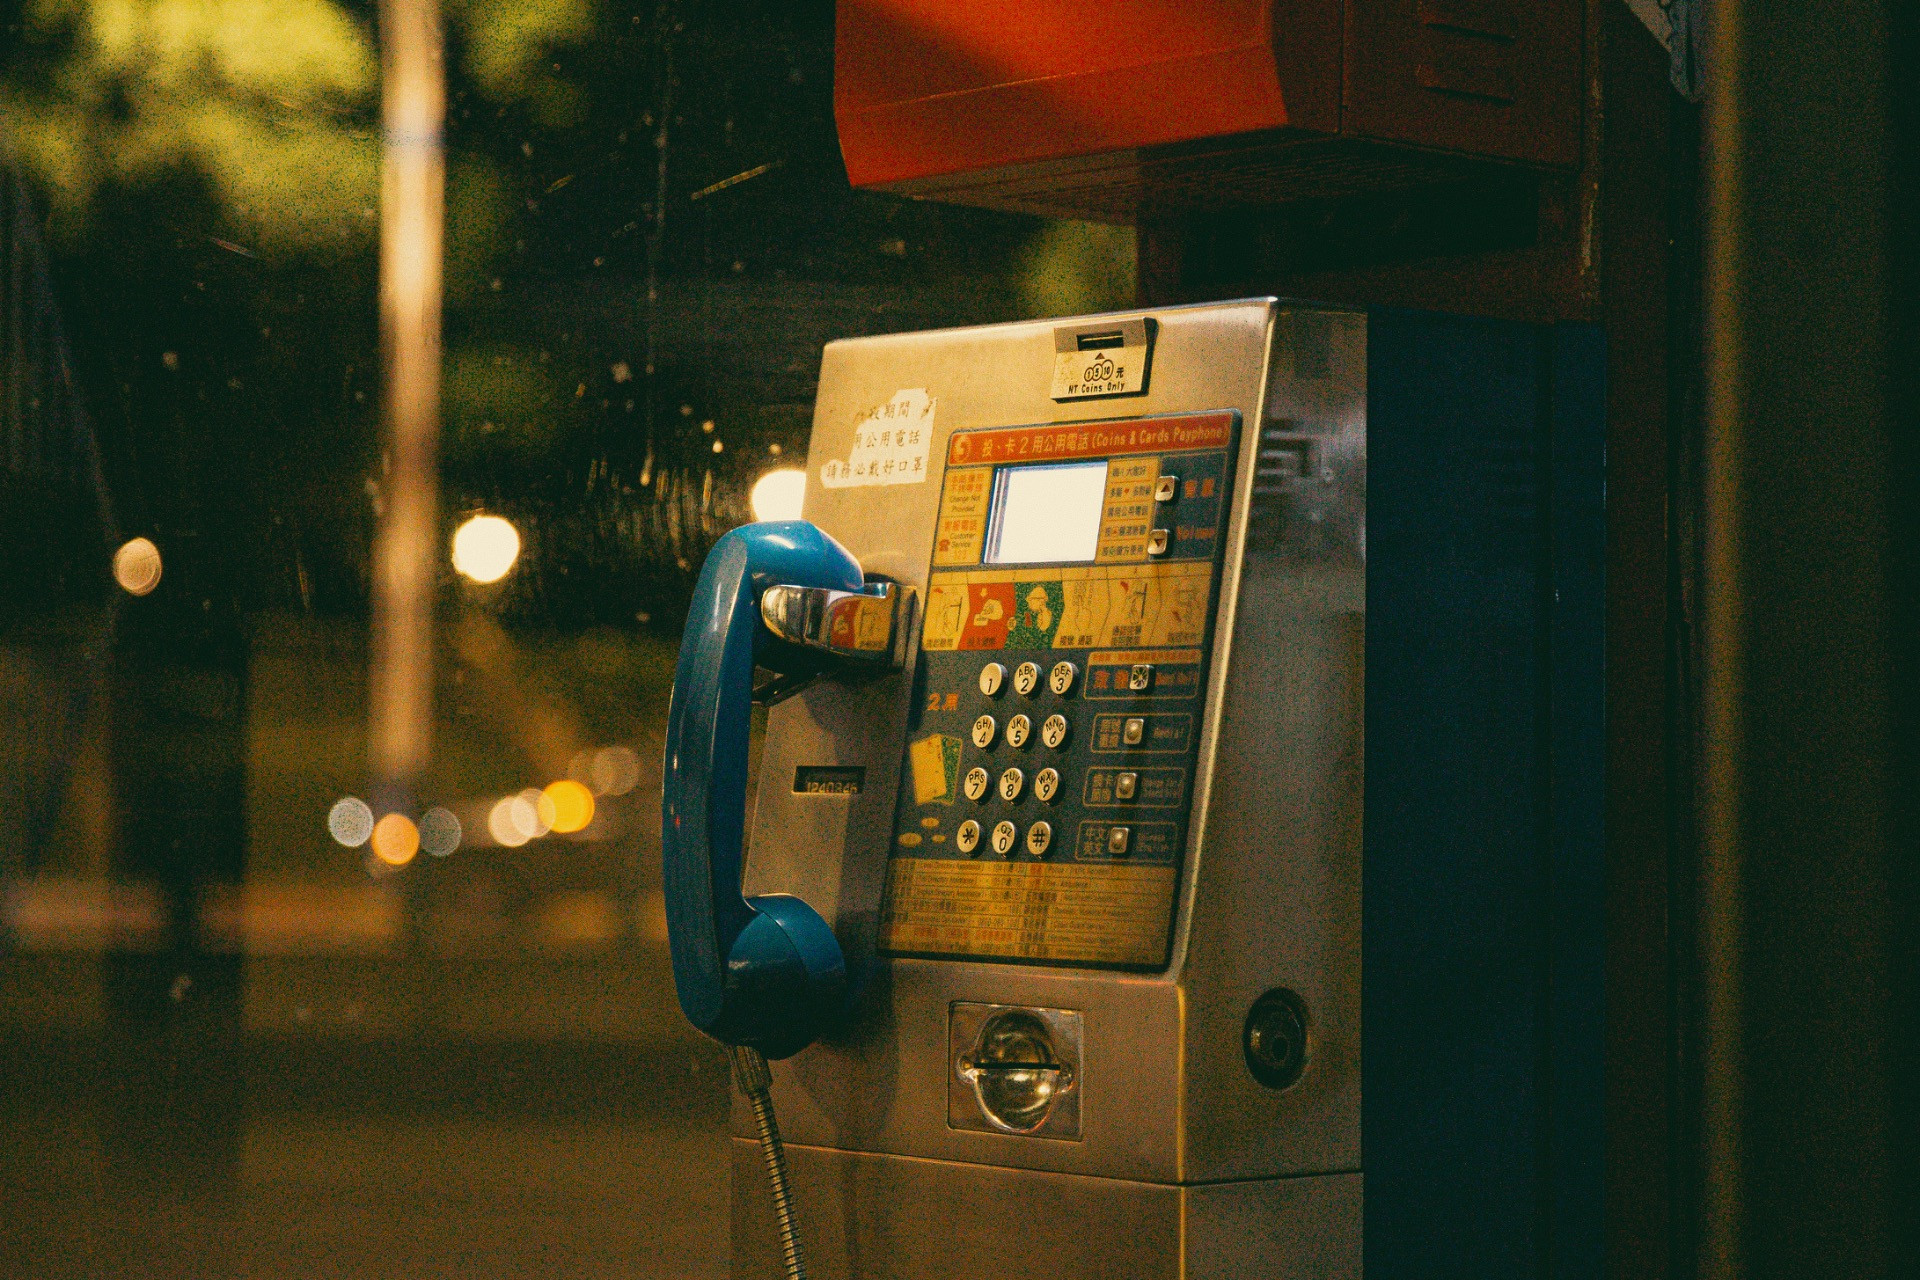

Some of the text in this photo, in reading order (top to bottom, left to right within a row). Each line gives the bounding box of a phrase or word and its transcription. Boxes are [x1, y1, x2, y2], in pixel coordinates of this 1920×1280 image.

[1094, 367, 1100, 378] 5
[1103, 365, 1111, 375] 10
[1115, 367, 1125, 379] 元
[1068, 381, 1126, 394] NT Coins Only
[1129, 430, 1137, 444] &
[1140, 428, 1170, 444] Cards
[1018, 666, 1034, 678] ABC
[1054, 665, 1071, 678] DEF
[987, 678, 993, 693] 1
[1021, 678, 1029, 692] 2
[1056, 677, 1064, 691] 3
[976, 719, 992, 730] GHI
[1011, 718, 1027, 730] JKL
[1045, 718, 1064, 732] MNO
[979, 732, 986, 745] 4
[1013, 731, 1021, 745] 5
[1049, 731, 1057, 745] 6
[968, 771, 985, 784] PRS
[1003, 771, 1020, 784] TUV
[1038, 772, 1056, 785] WXY
[971, 783, 979, 796] 7
[1006, 783, 1014, 797] 8
[1043, 784, 1050, 798] 9
[999, 837, 1007, 851] 0
